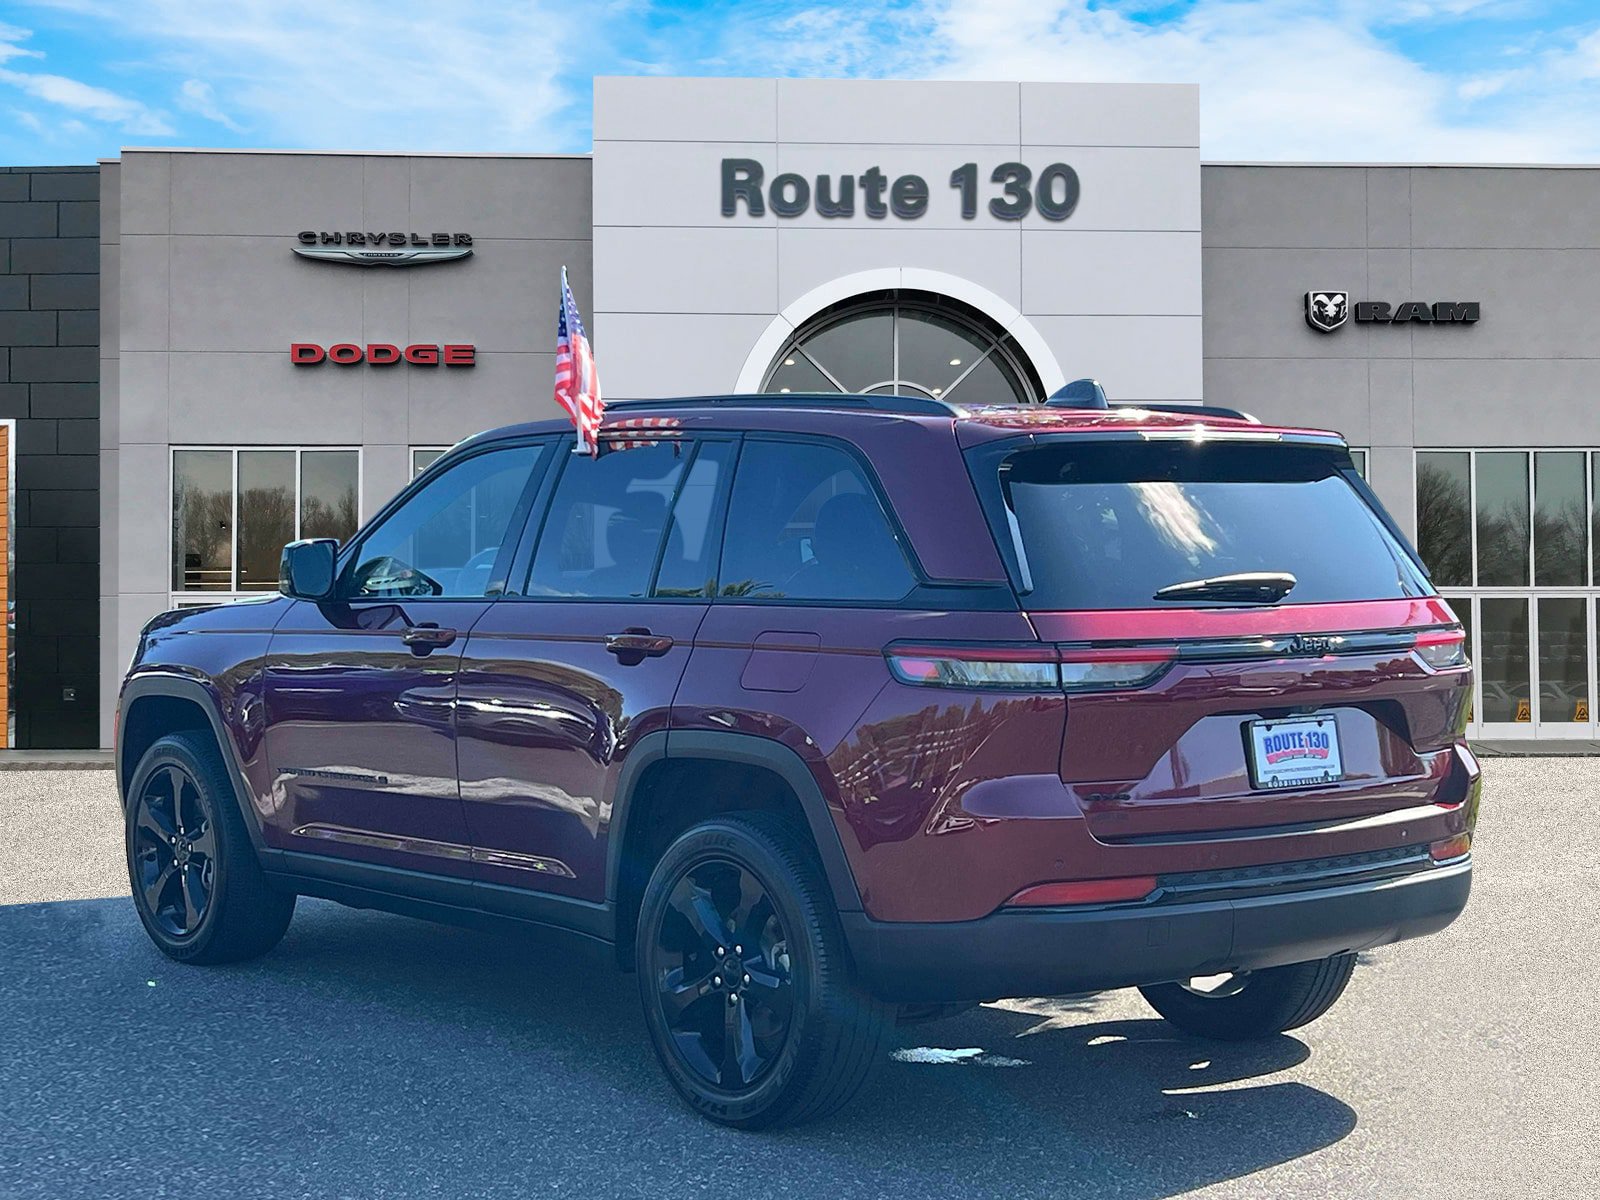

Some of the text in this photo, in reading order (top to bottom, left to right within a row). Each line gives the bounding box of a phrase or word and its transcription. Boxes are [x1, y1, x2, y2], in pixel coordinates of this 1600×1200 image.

[721, 158, 1080, 221] Route 130
[298, 231, 473, 246] CHRYSLER
[1355, 301, 1480, 323] RAM
[291, 344, 475, 365] DODGE
[1290, 633, 1334, 654] Jeep
[1264, 731, 1330, 754] ROUTE 130
